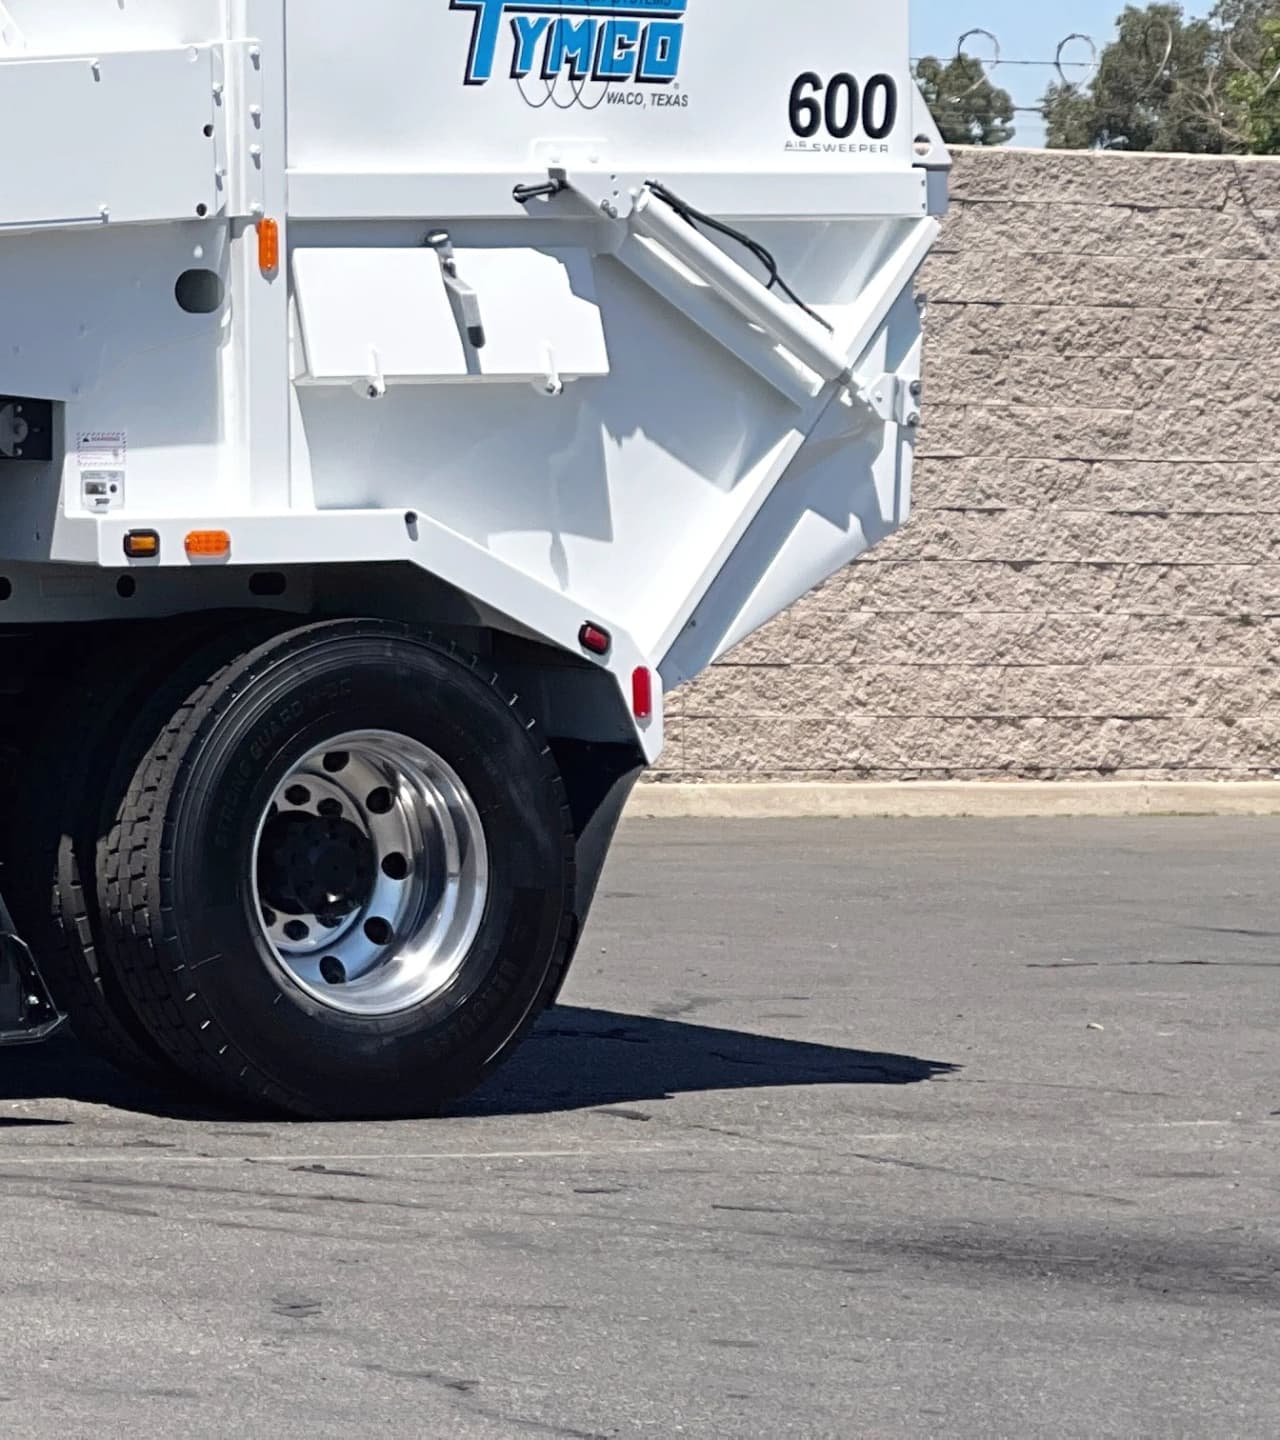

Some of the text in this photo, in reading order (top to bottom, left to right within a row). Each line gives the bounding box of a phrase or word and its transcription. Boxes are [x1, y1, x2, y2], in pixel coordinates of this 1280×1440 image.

[606, 91, 689, 109] WACO, TEXAS
[788, 71, 898, 139] 600
[812, 143, 889, 153] SWEEPER
